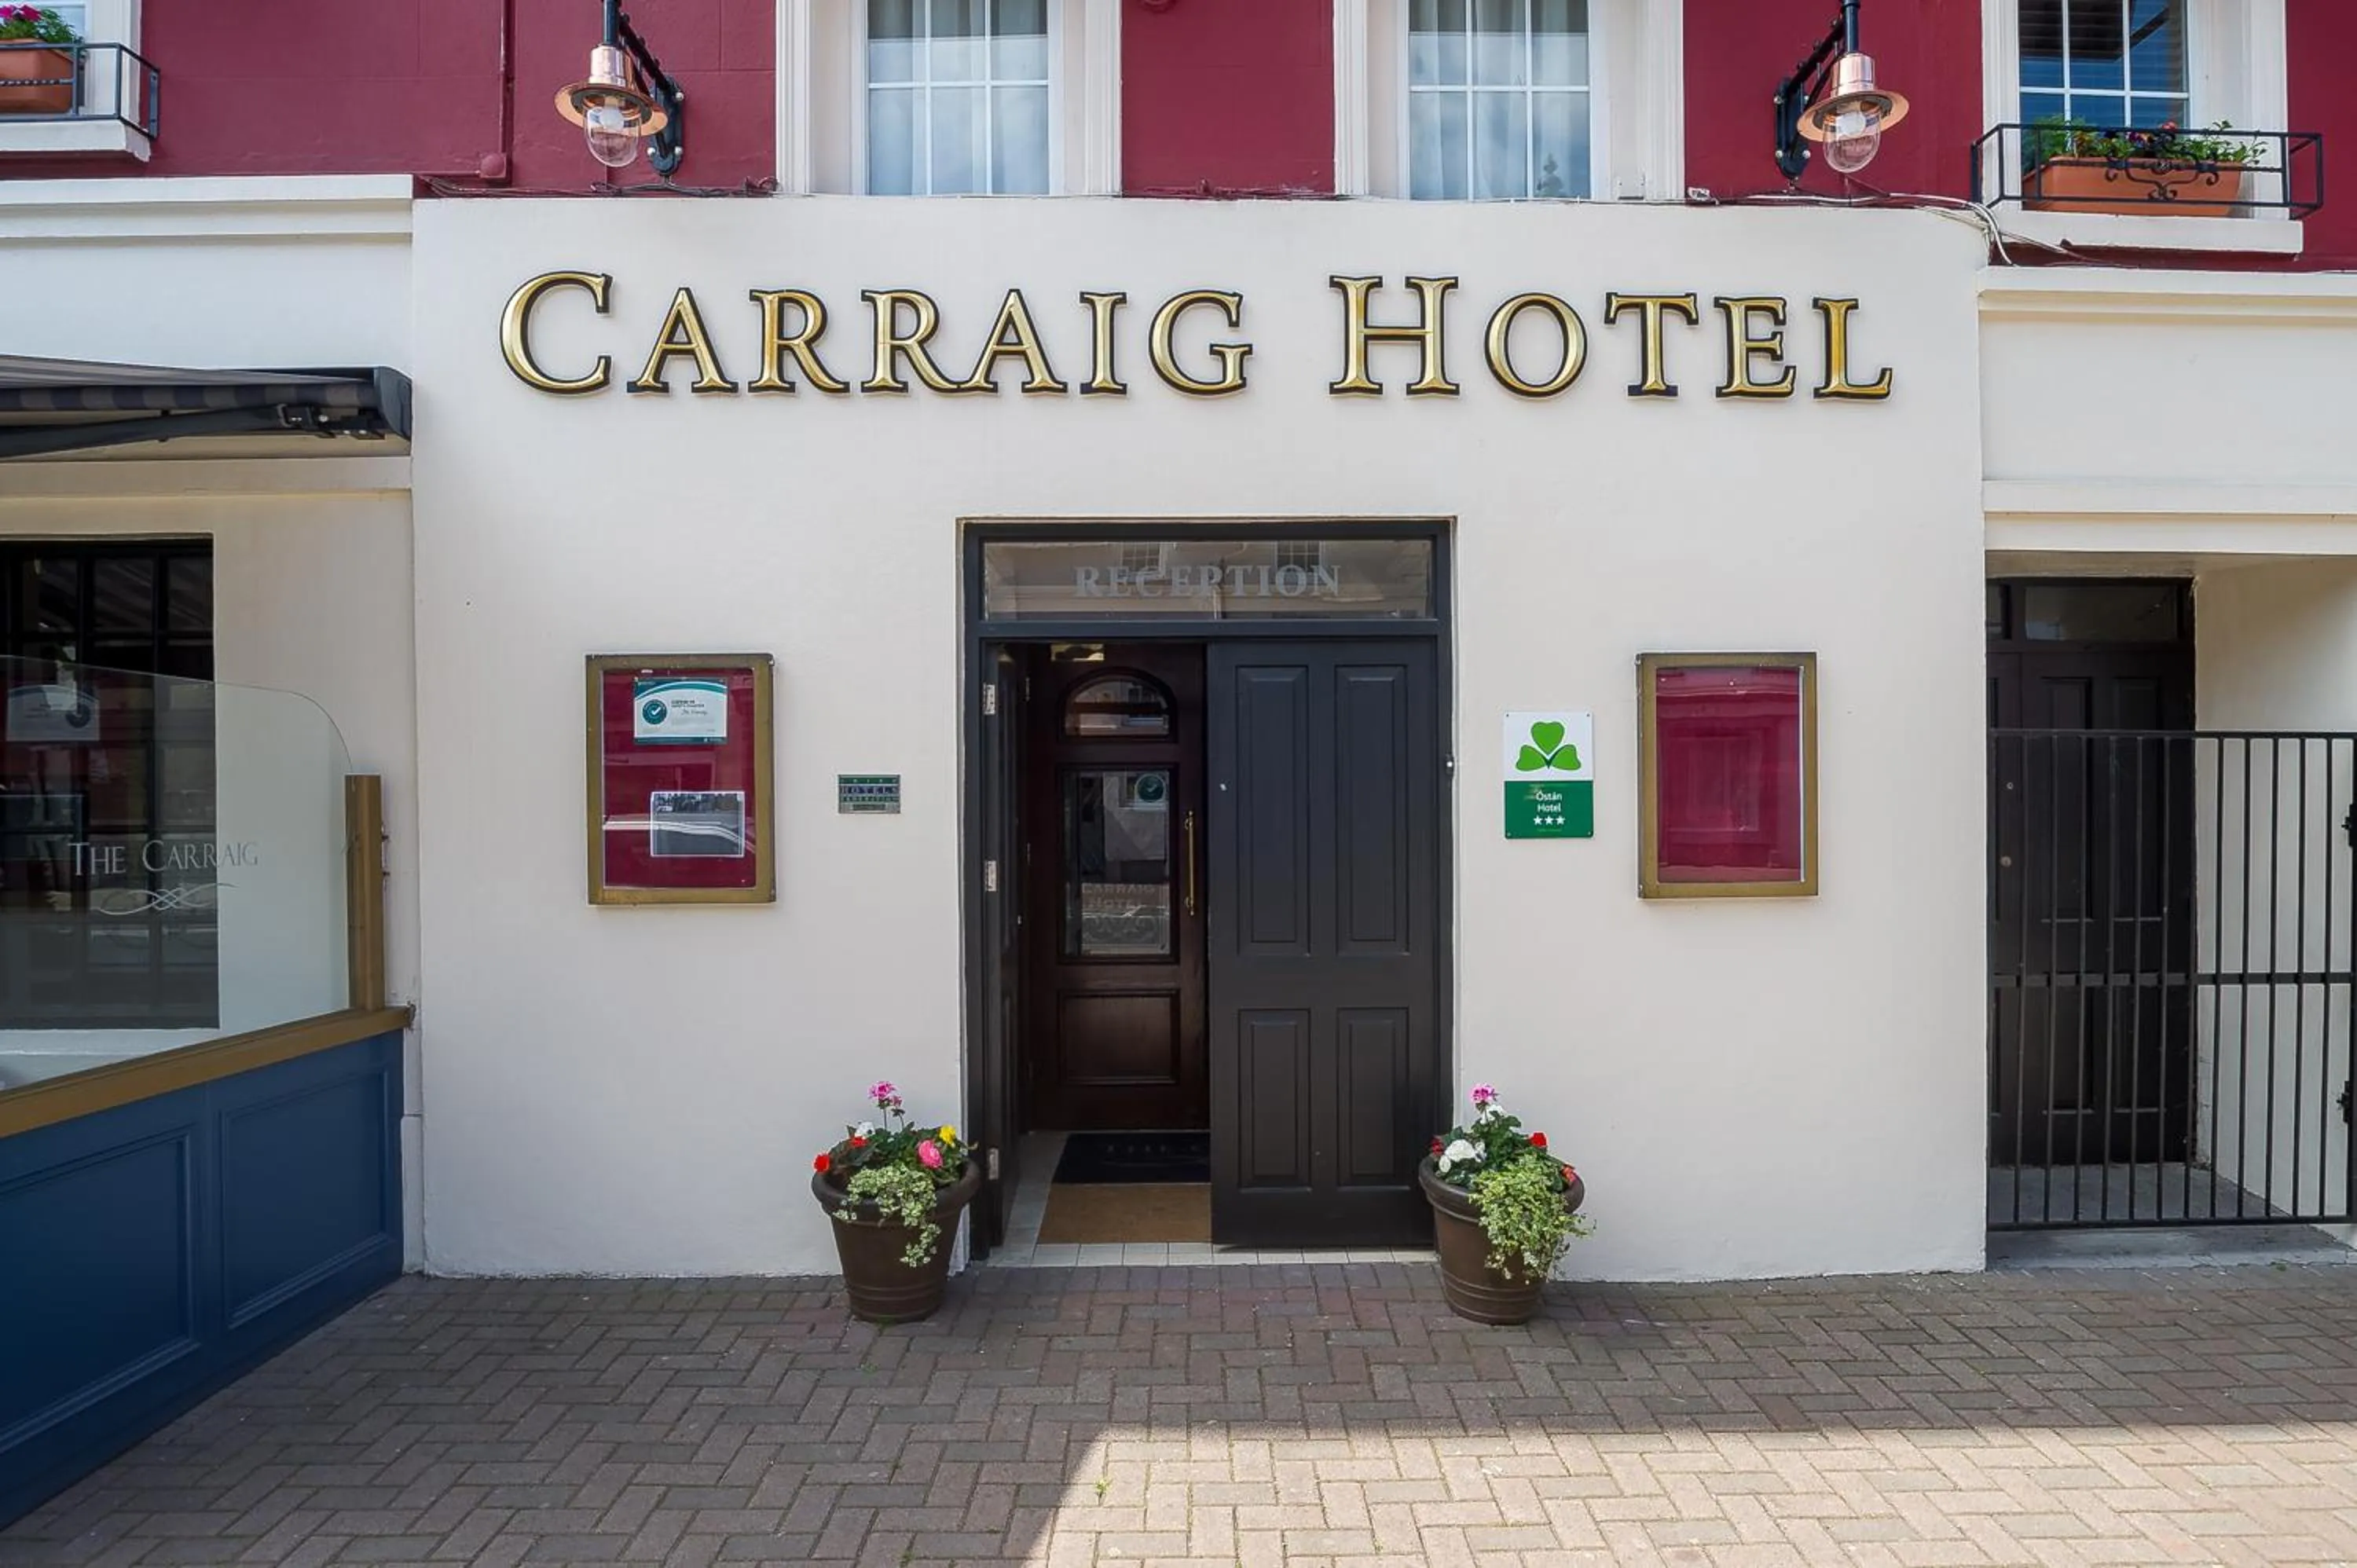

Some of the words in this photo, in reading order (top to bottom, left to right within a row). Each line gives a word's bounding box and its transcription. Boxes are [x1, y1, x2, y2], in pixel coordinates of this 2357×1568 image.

[500, 270, 1254, 395] CARRAIG
[1329, 274, 1893, 399] HOTEL
[1073, 564, 1341, 599] RECEPTION
[1536, 789, 1563, 801] Óstán
[1538, 803, 1561, 812] Hotel
[68, 841, 126, 876] THE
[142, 840, 258, 873] CARRAIG
